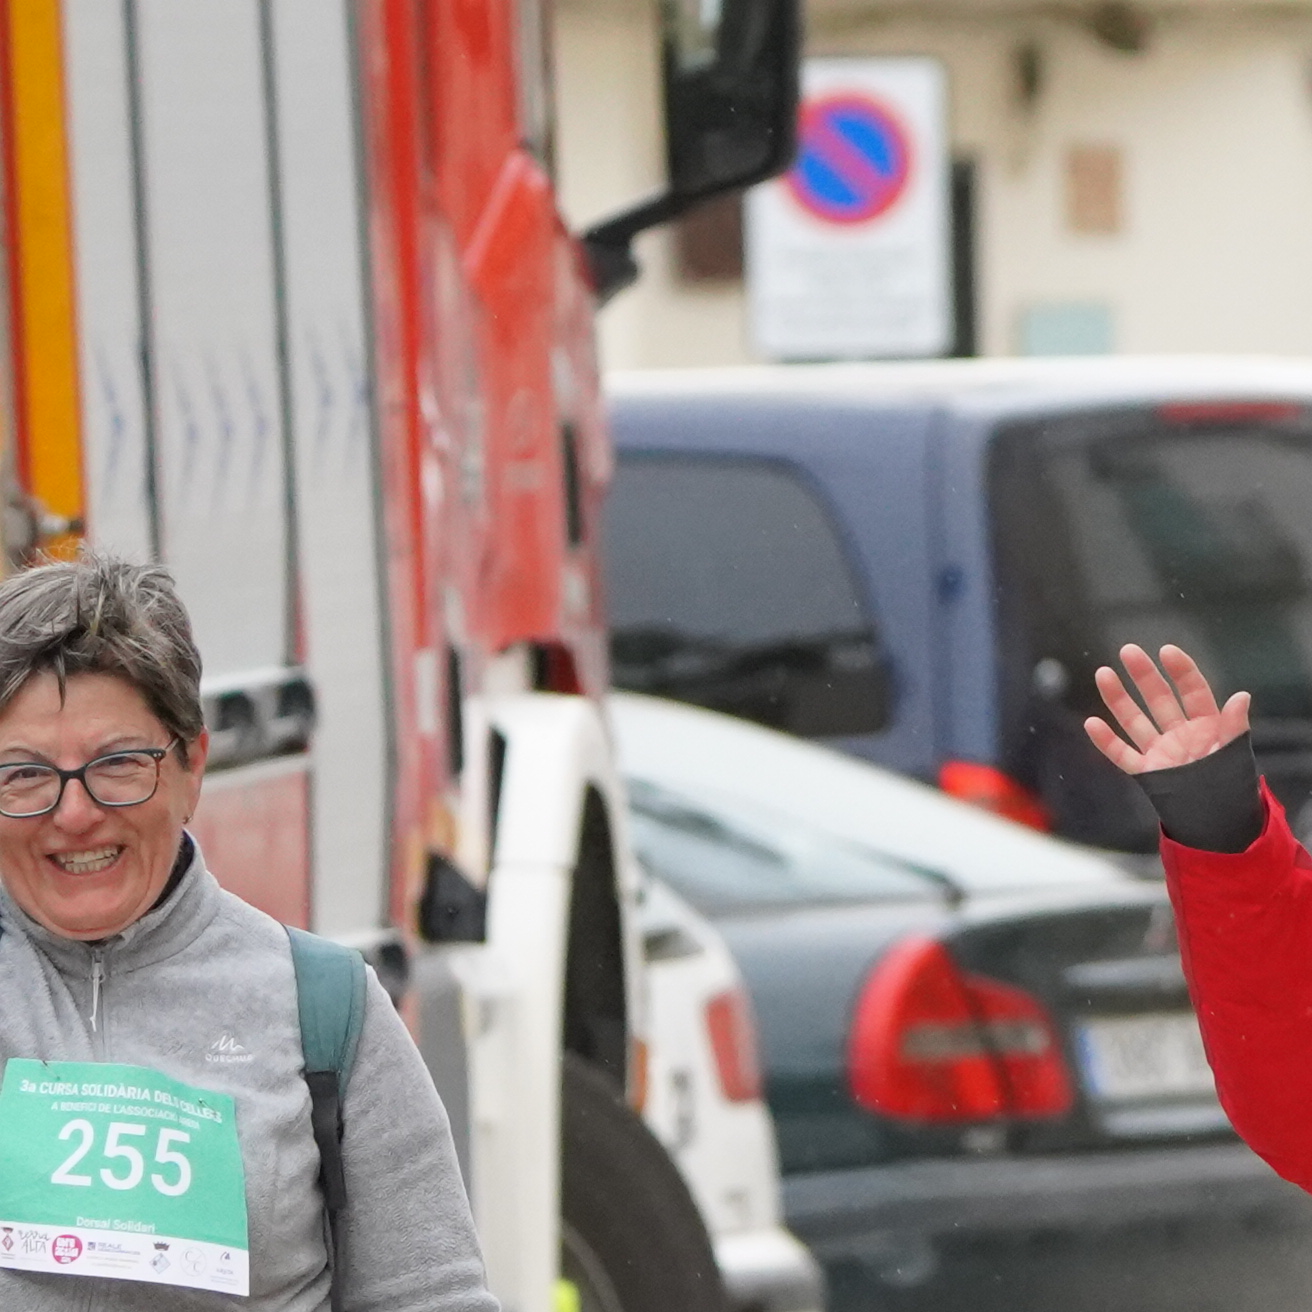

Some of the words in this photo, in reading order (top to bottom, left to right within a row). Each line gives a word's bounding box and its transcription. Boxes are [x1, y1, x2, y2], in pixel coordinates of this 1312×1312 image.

[20, 1080, 36, 1093] 3a
[39, 1083, 79, 1096] CURSA
[81, 1083, 151, 1101] SOLIDÀRIA
[51, 1102, 59, 1111] A
[98, 1104, 111, 1113] DE
[51, 1118, 192, 1197] 255
[76, 1216, 111, 1229] Dorsal
[114, 1219, 156, 1234] Solidari
